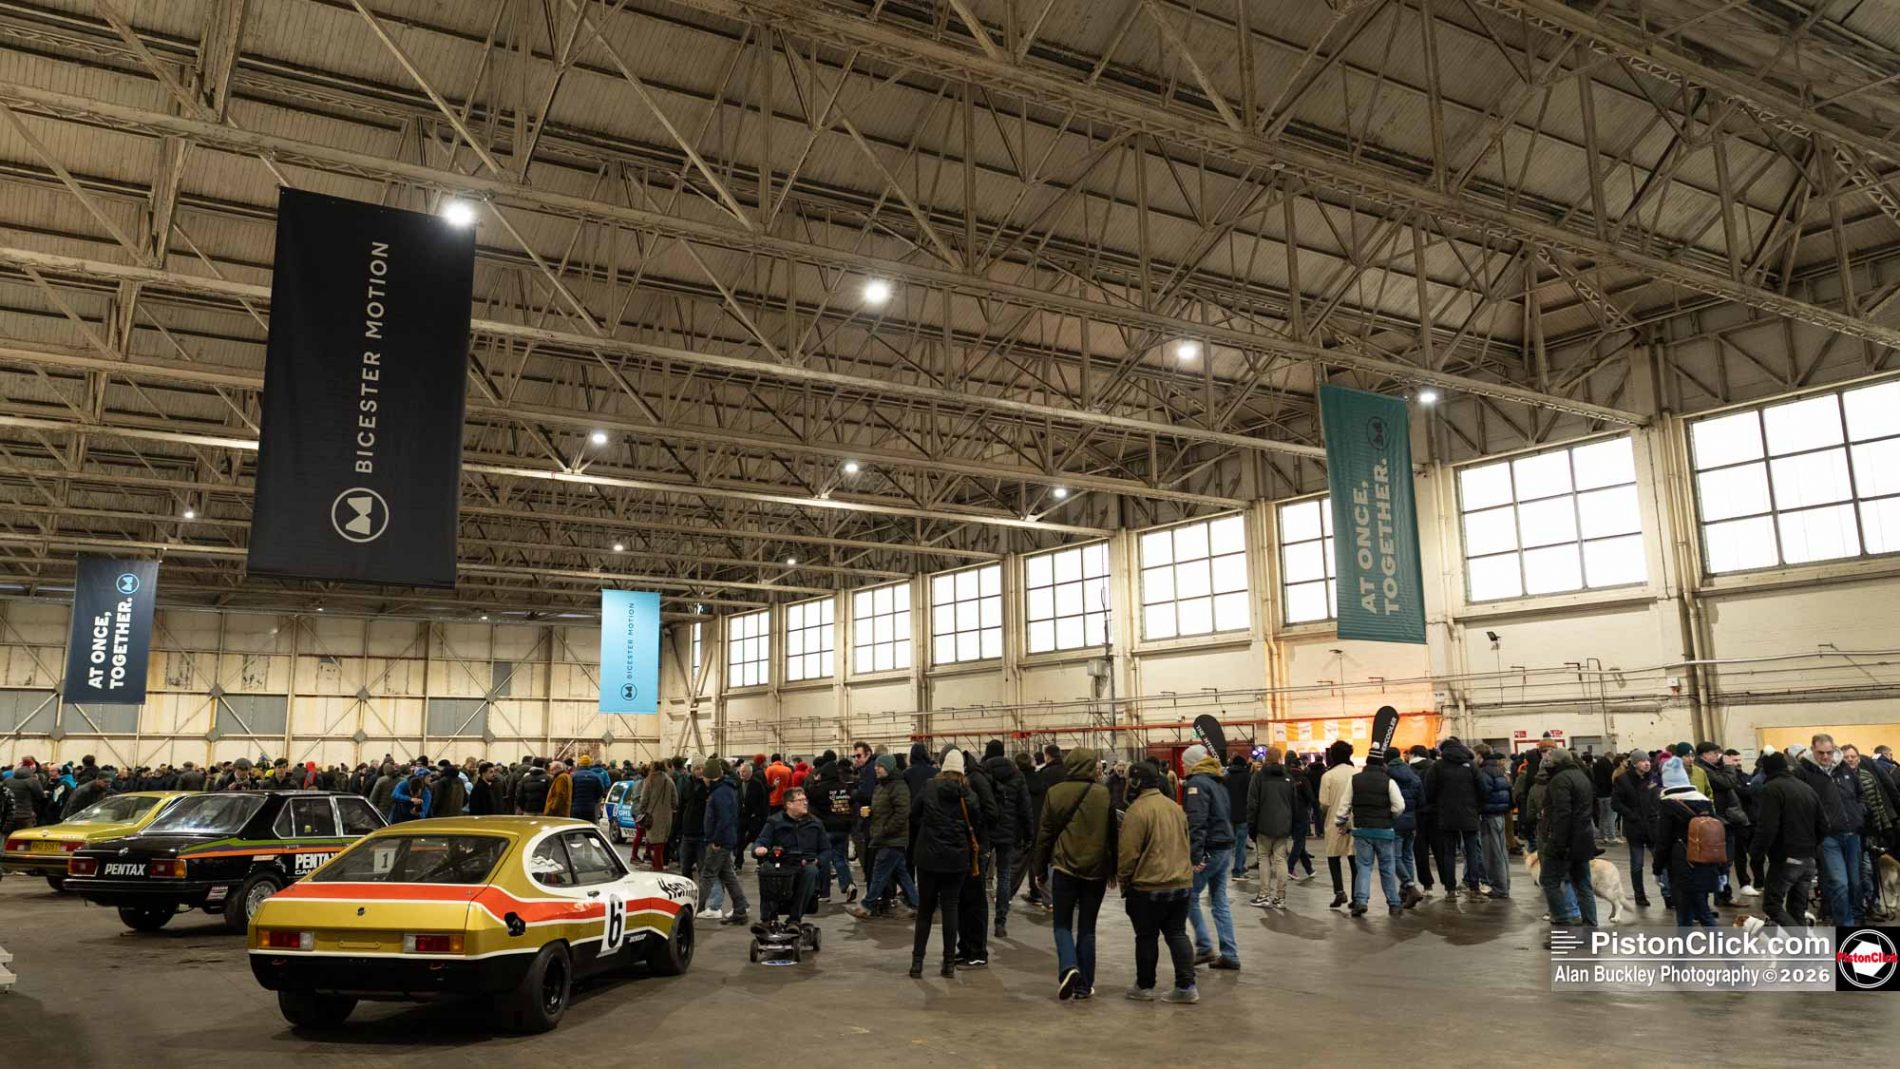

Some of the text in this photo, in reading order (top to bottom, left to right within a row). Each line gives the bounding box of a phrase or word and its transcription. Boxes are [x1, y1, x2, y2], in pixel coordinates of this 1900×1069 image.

[354, 241, 390, 474] BICESTER MOTION
[1353, 480, 1377, 616] AT ONCE,
[1373, 458, 1400, 616] TOGETHER.
[88, 611, 112, 689] AT ONCE,
[109, 597, 133, 690] TOGETHER.
[626, 639, 634, 679] BICESTER
[1381, 716, 1397, 751] ERCOOLER
[104, 863, 147, 876] PENTAX
[381, 852, 389, 869] 1
[608, 893, 623, 948] 6
